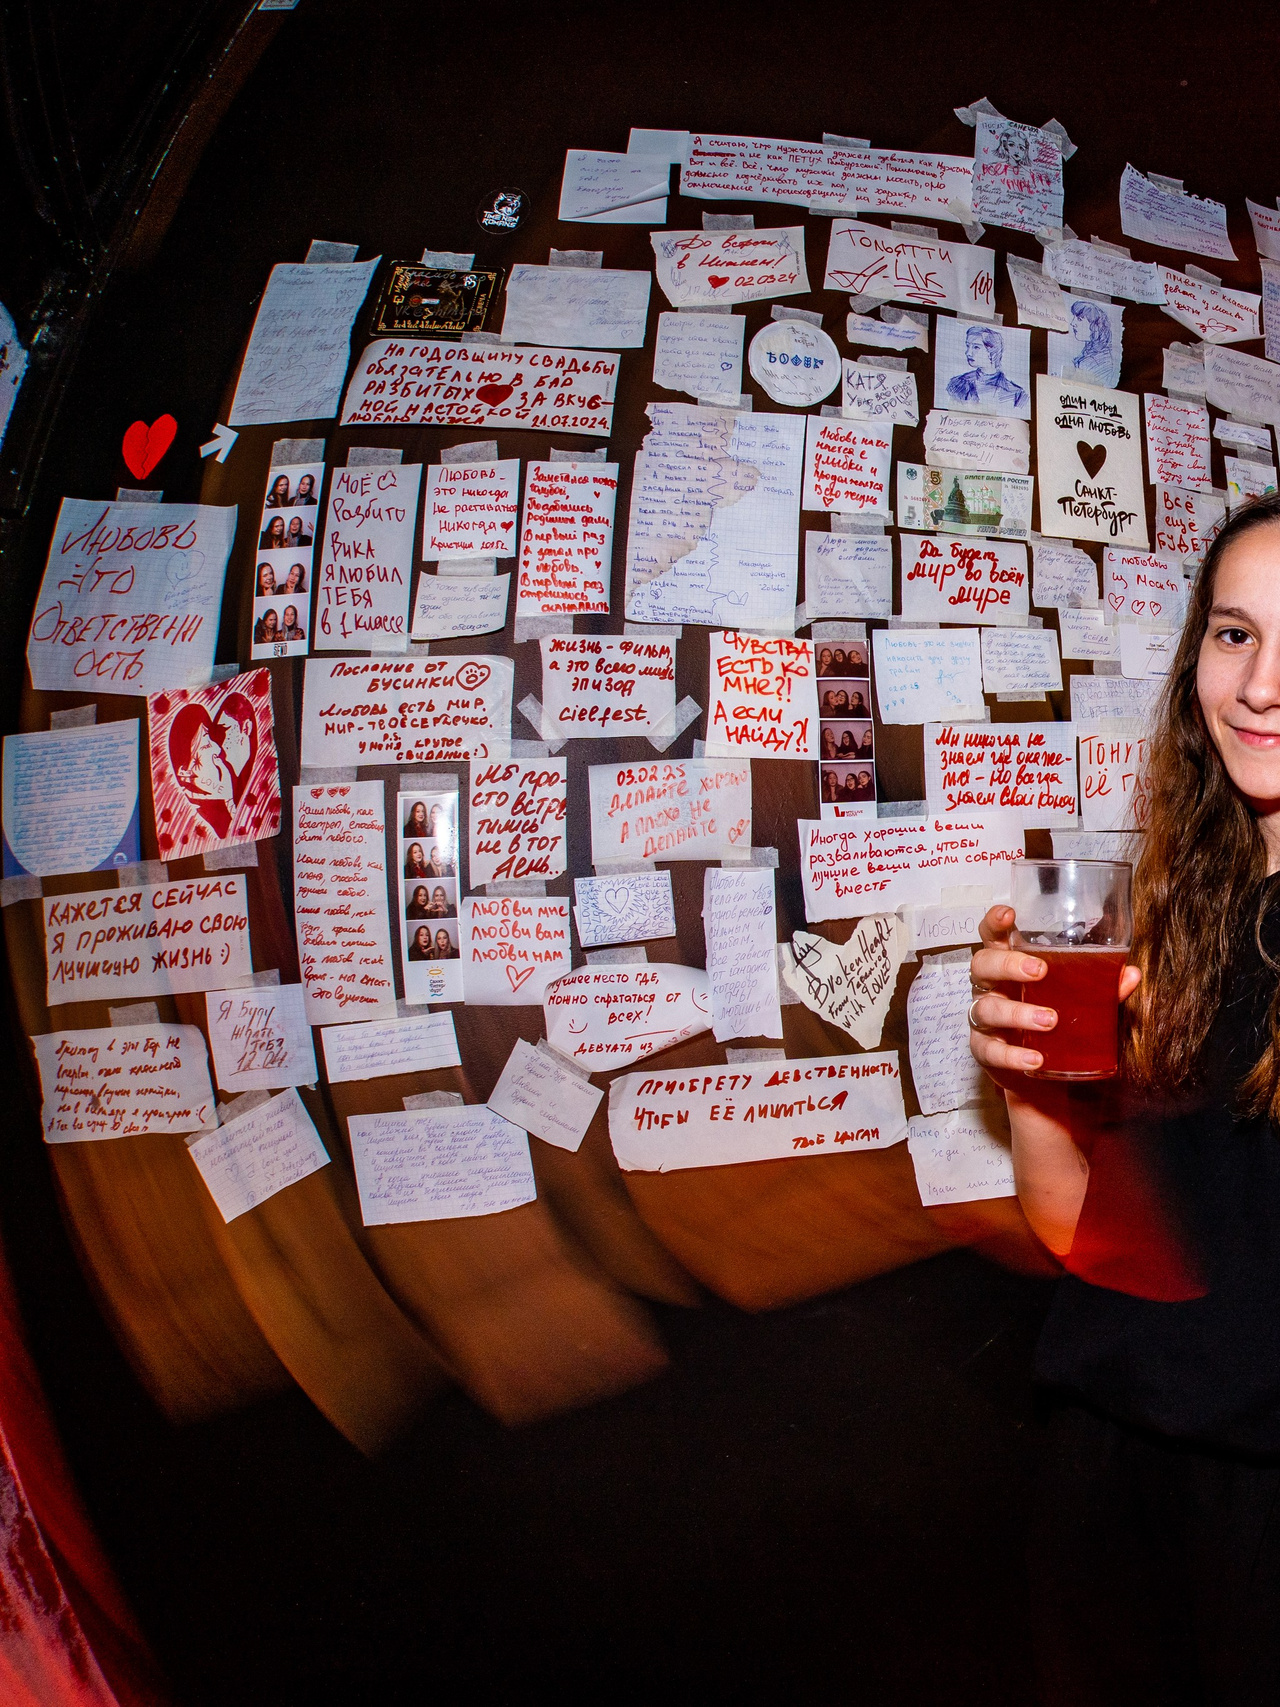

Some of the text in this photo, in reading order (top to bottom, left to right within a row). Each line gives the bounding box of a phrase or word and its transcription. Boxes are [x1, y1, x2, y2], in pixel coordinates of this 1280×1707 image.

[529, 355, 615, 376] СВАДЬБЫ
[534, 377, 573, 388] БАР
[1089, 419, 1131, 439] ЛЮБОВЬ
[930, 471, 941, 485] 5
[1057, 496, 1137, 536] Петербург
[200, 778, 223, 794] LOVE
